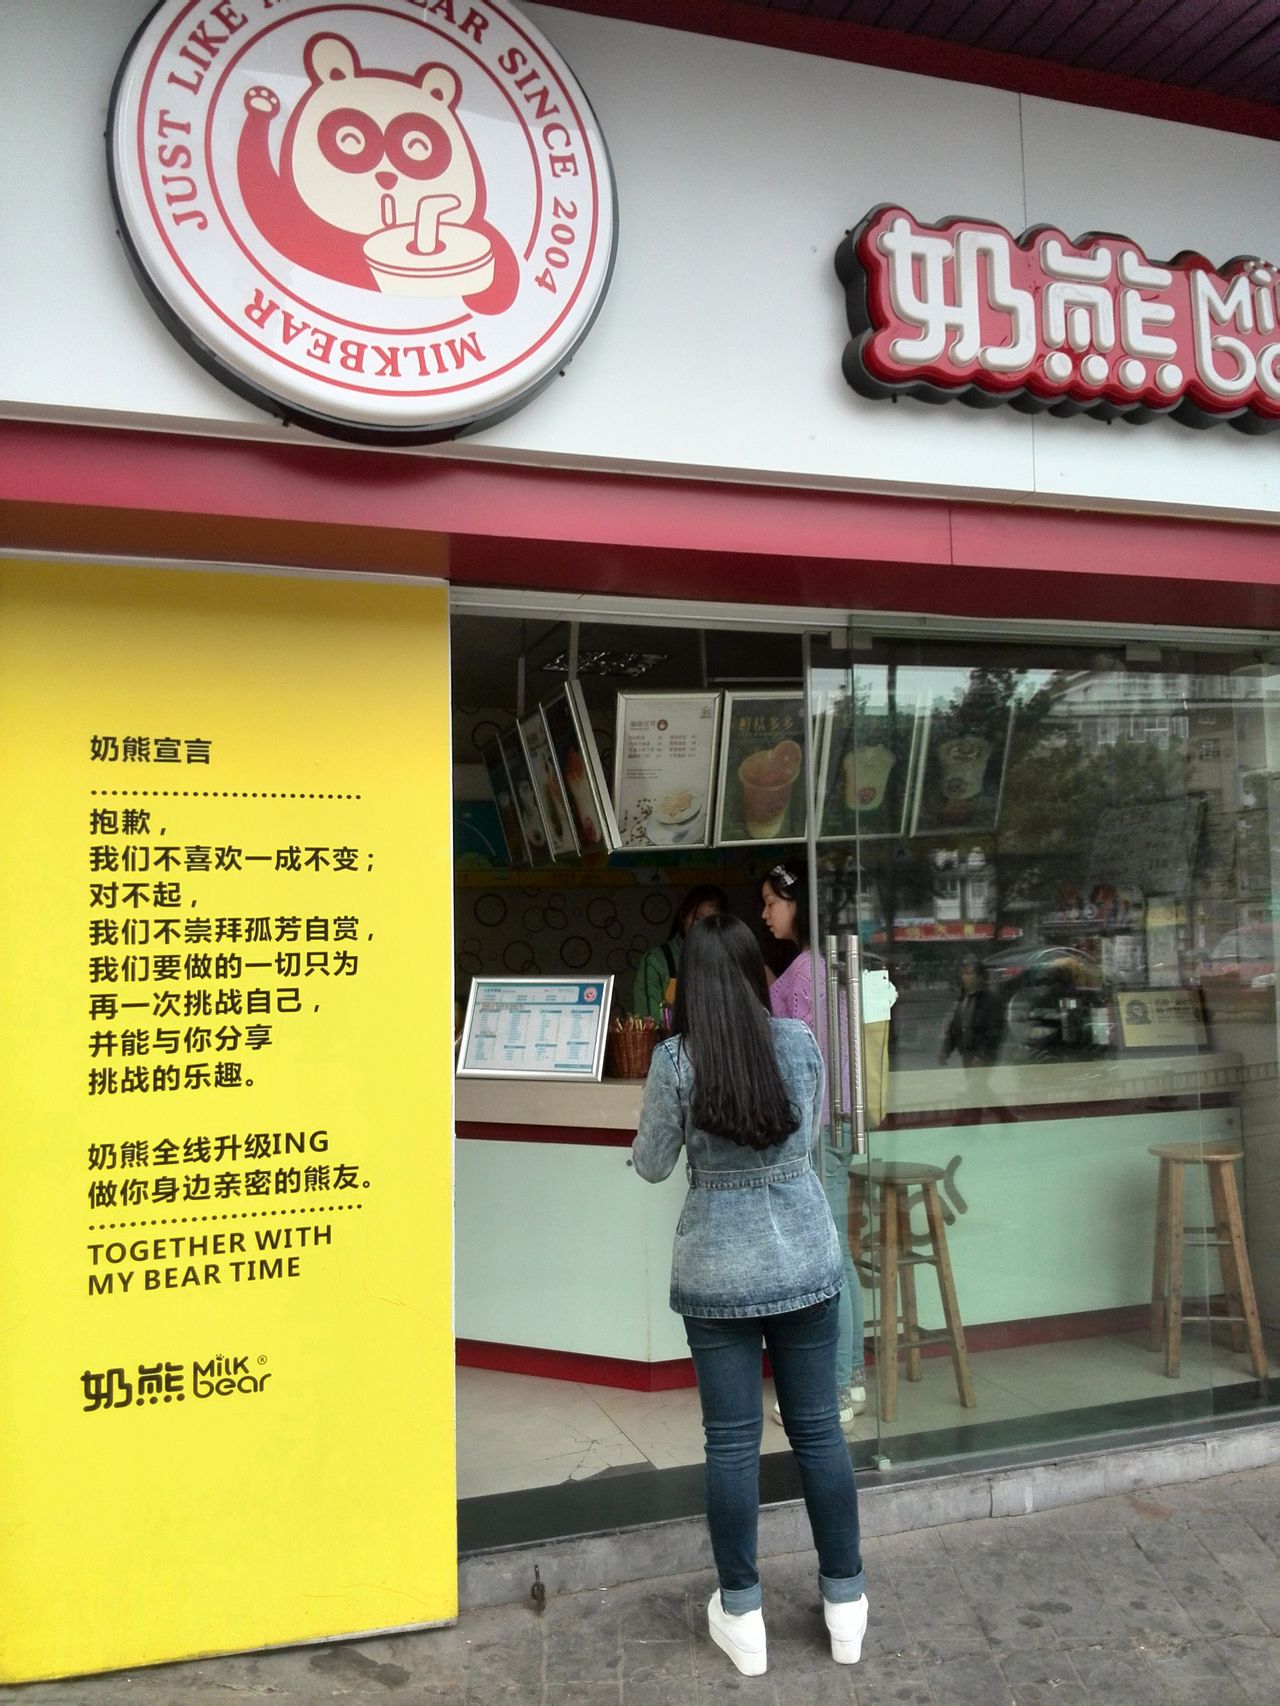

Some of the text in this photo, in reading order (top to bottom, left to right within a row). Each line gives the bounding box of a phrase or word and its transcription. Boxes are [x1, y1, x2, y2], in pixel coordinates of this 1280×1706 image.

[158, 0, 580, 295] JUST LIKE AR SINCE 2004
[877, 217, 1184, 394] 奶熊
[243, 287, 487, 378] MILKBEAR
[91, 735, 212, 765] 奶熊宣言
[89, 951, 359, 983] 我们要做的一切只为
[89, 1024, 273, 1058] 并能与你分享
[88, 1061, 255, 1096] 挑战的乐趣。
[88, 1130, 329, 1171] 奶熊全线升级ING
[88, 1163, 371, 1210] 做你身边亲密的熊友。
[87, 1225, 332, 1266] TOGETHER WITH
[87, 1256, 301, 1296] MY BEAR TIME
[80, 1361, 186, 1413] 奶熊
[192, 1372, 272, 1399] bear
